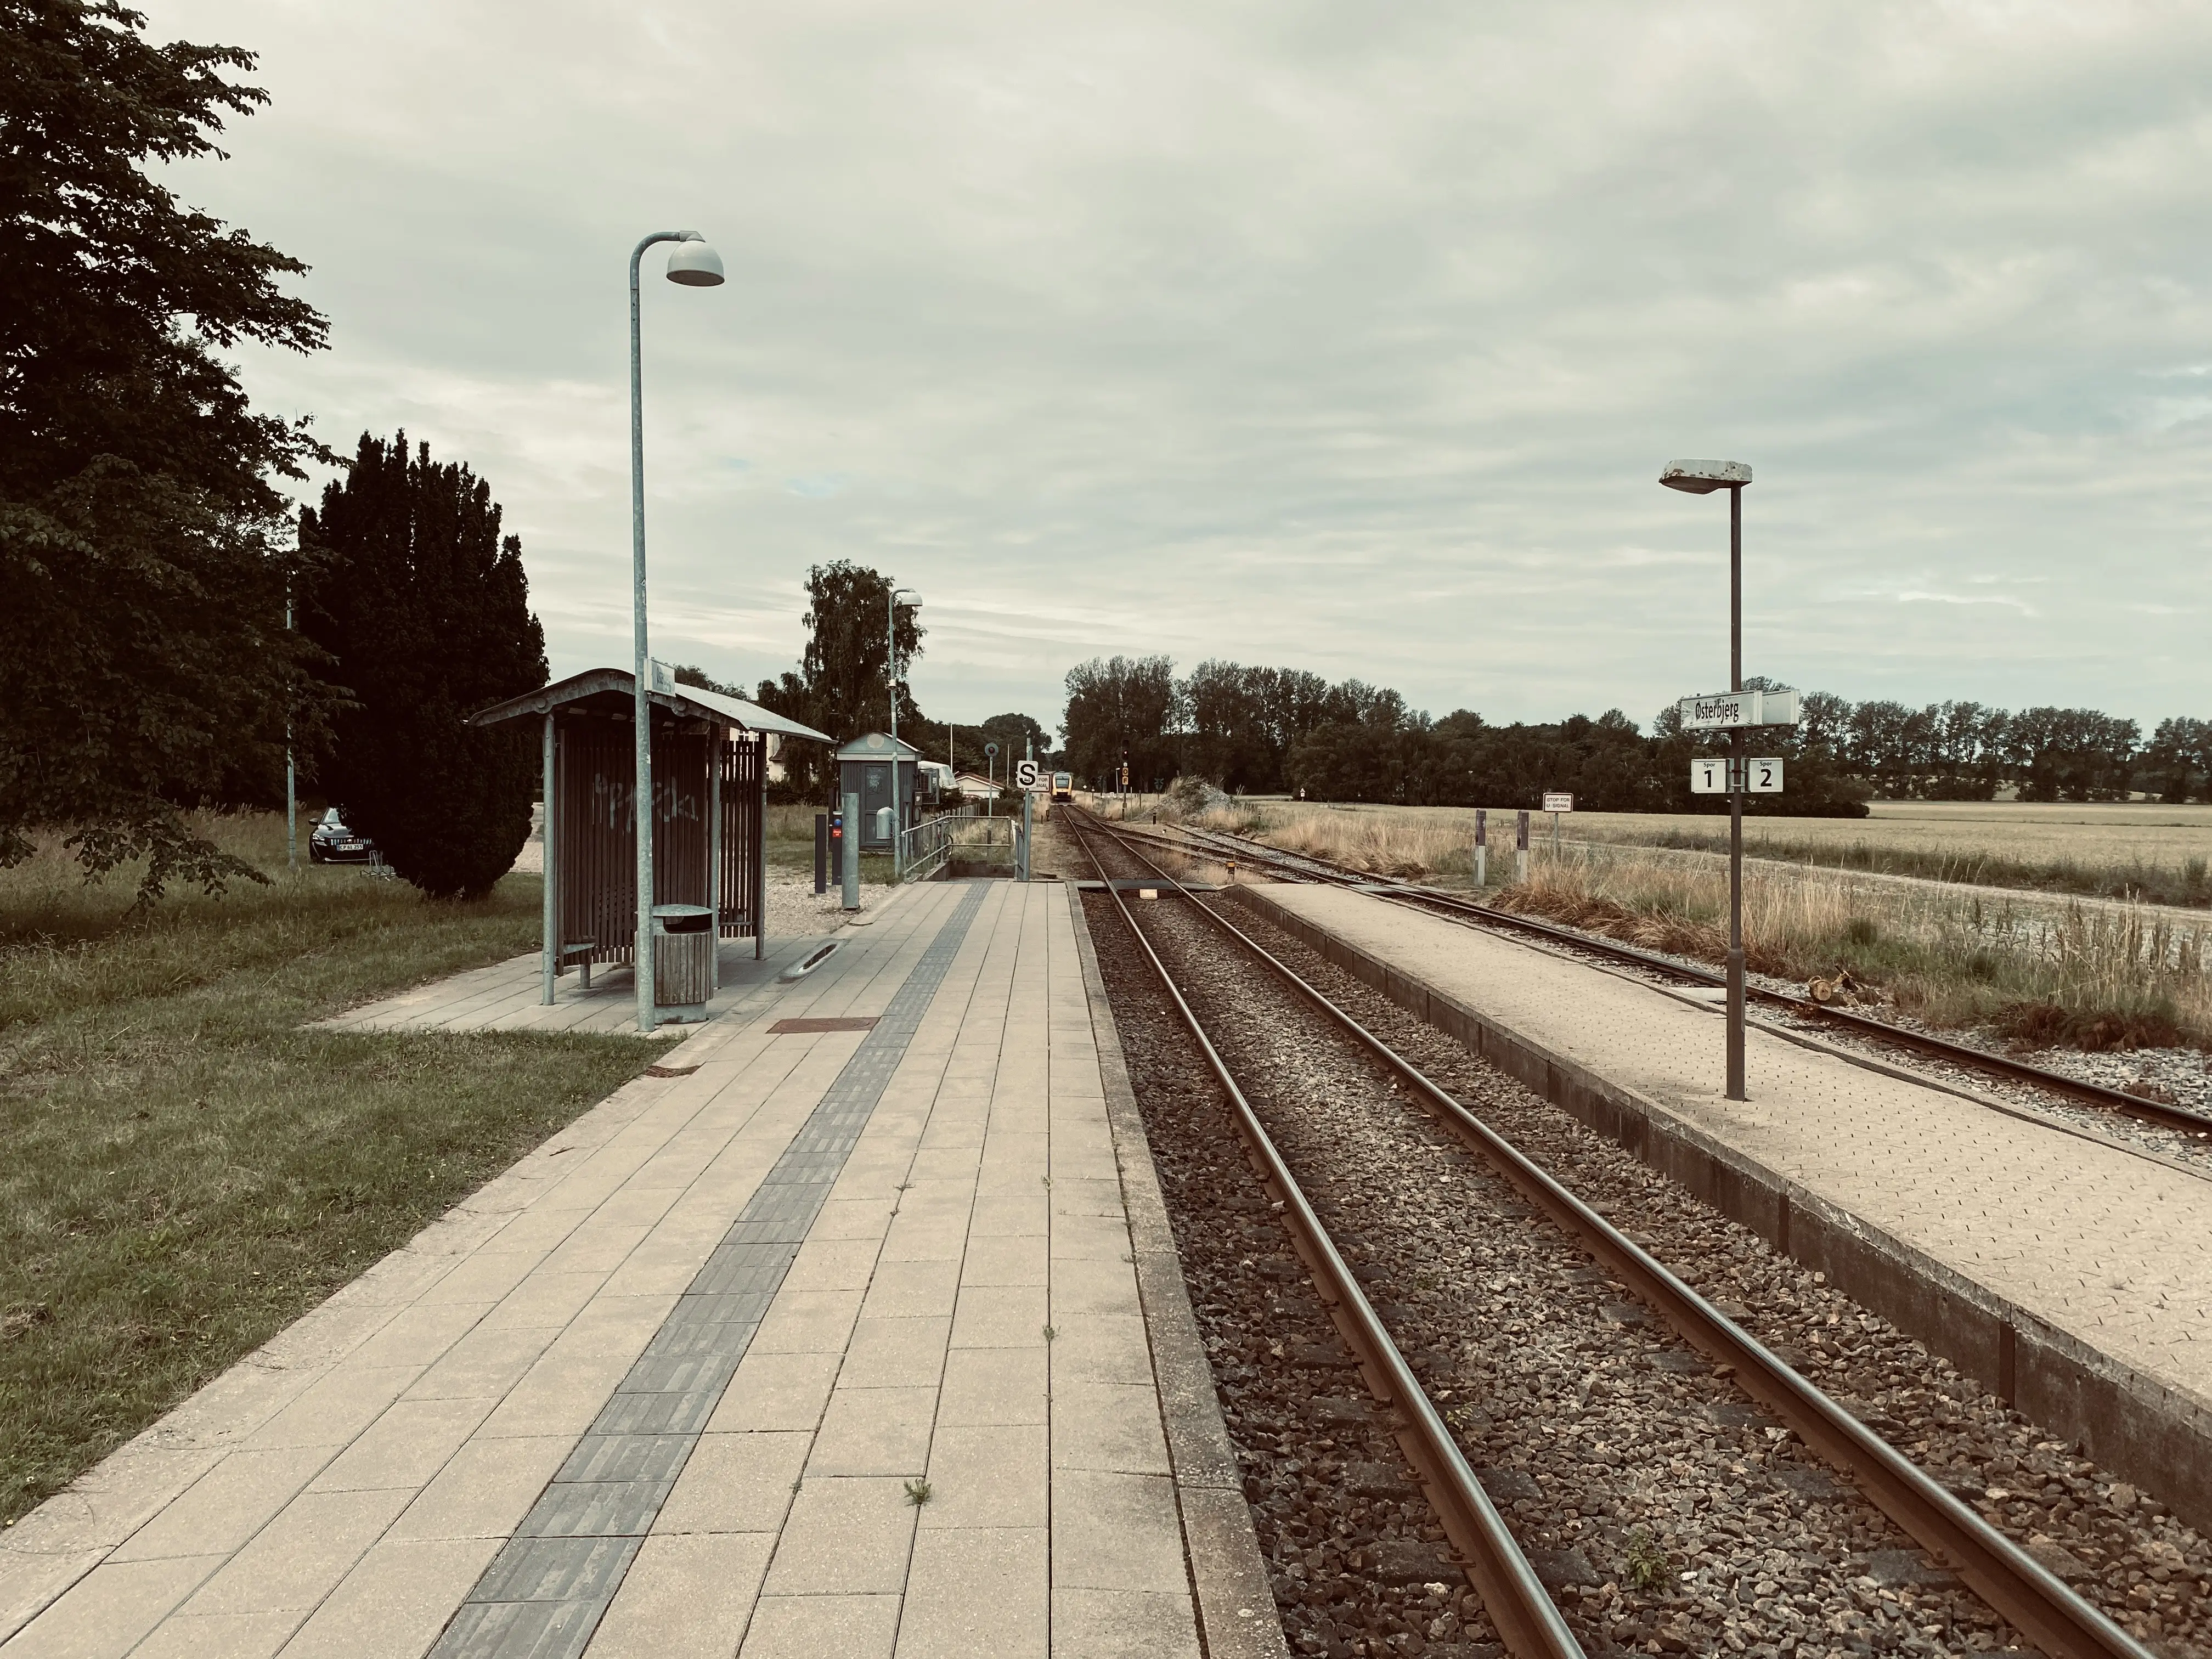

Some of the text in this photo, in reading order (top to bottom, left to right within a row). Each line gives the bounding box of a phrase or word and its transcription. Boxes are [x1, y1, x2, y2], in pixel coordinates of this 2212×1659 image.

[1695, 698, 1739, 724] Østerbjerg
[1019, 764, 1036, 786] S
[1704, 770, 1712, 788] 1
[1760, 769, 1772, 787] 2
